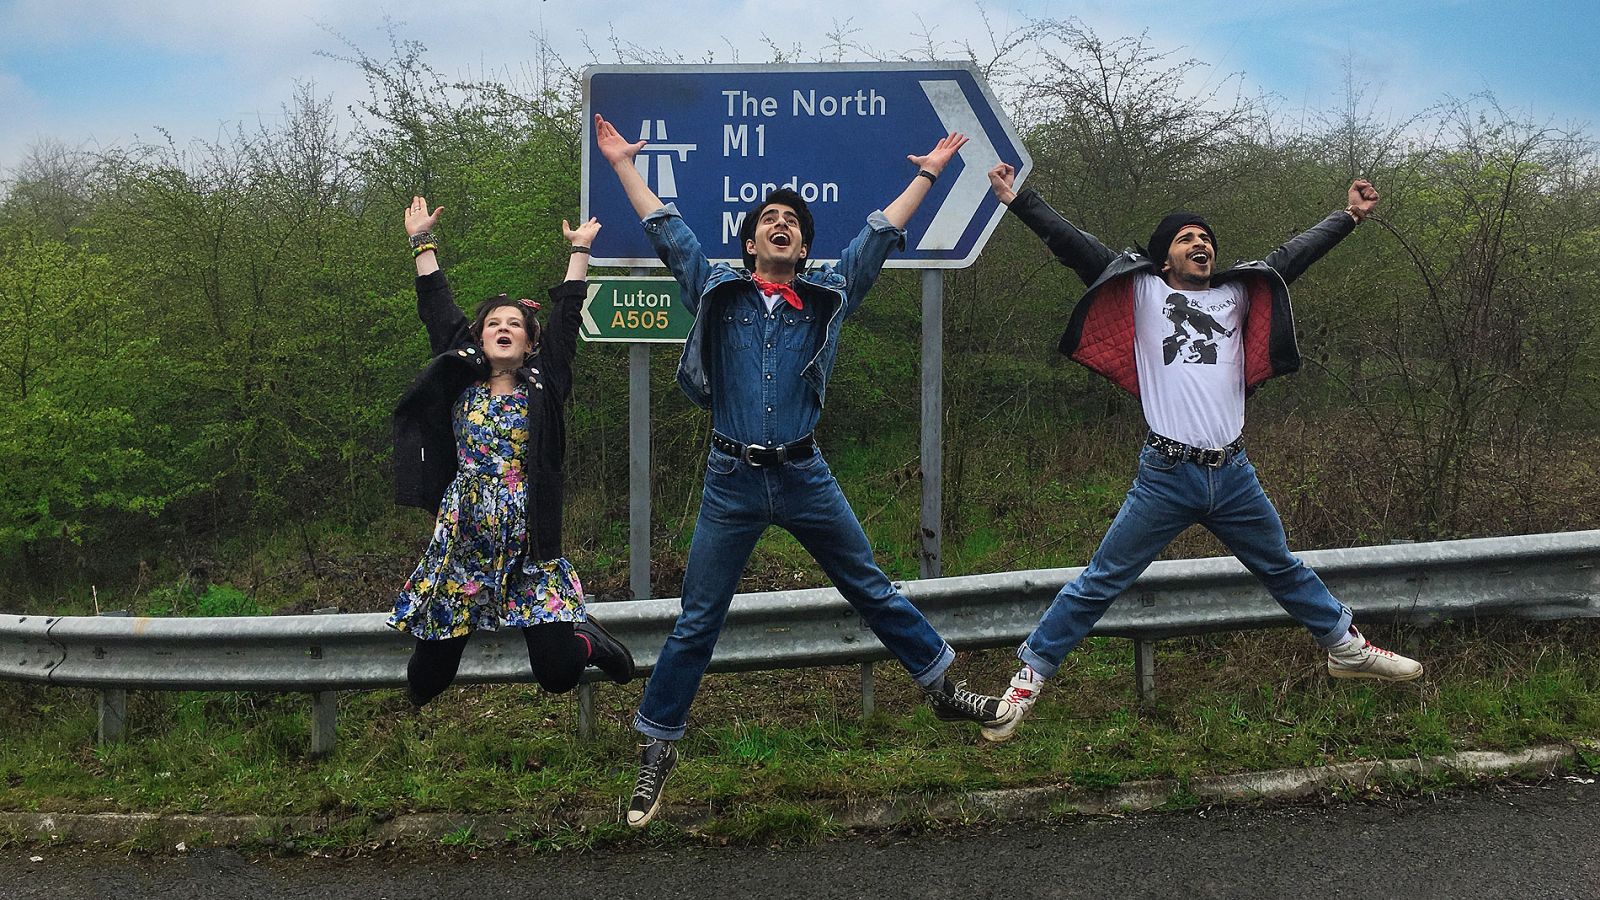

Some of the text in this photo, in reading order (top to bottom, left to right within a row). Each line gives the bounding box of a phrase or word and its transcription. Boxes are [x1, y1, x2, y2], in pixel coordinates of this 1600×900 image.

[721, 89, 886, 117] The North
[723, 124, 765, 157] M1
[613, 289, 671, 308] Luton
[611, 310, 669, 330] A505
